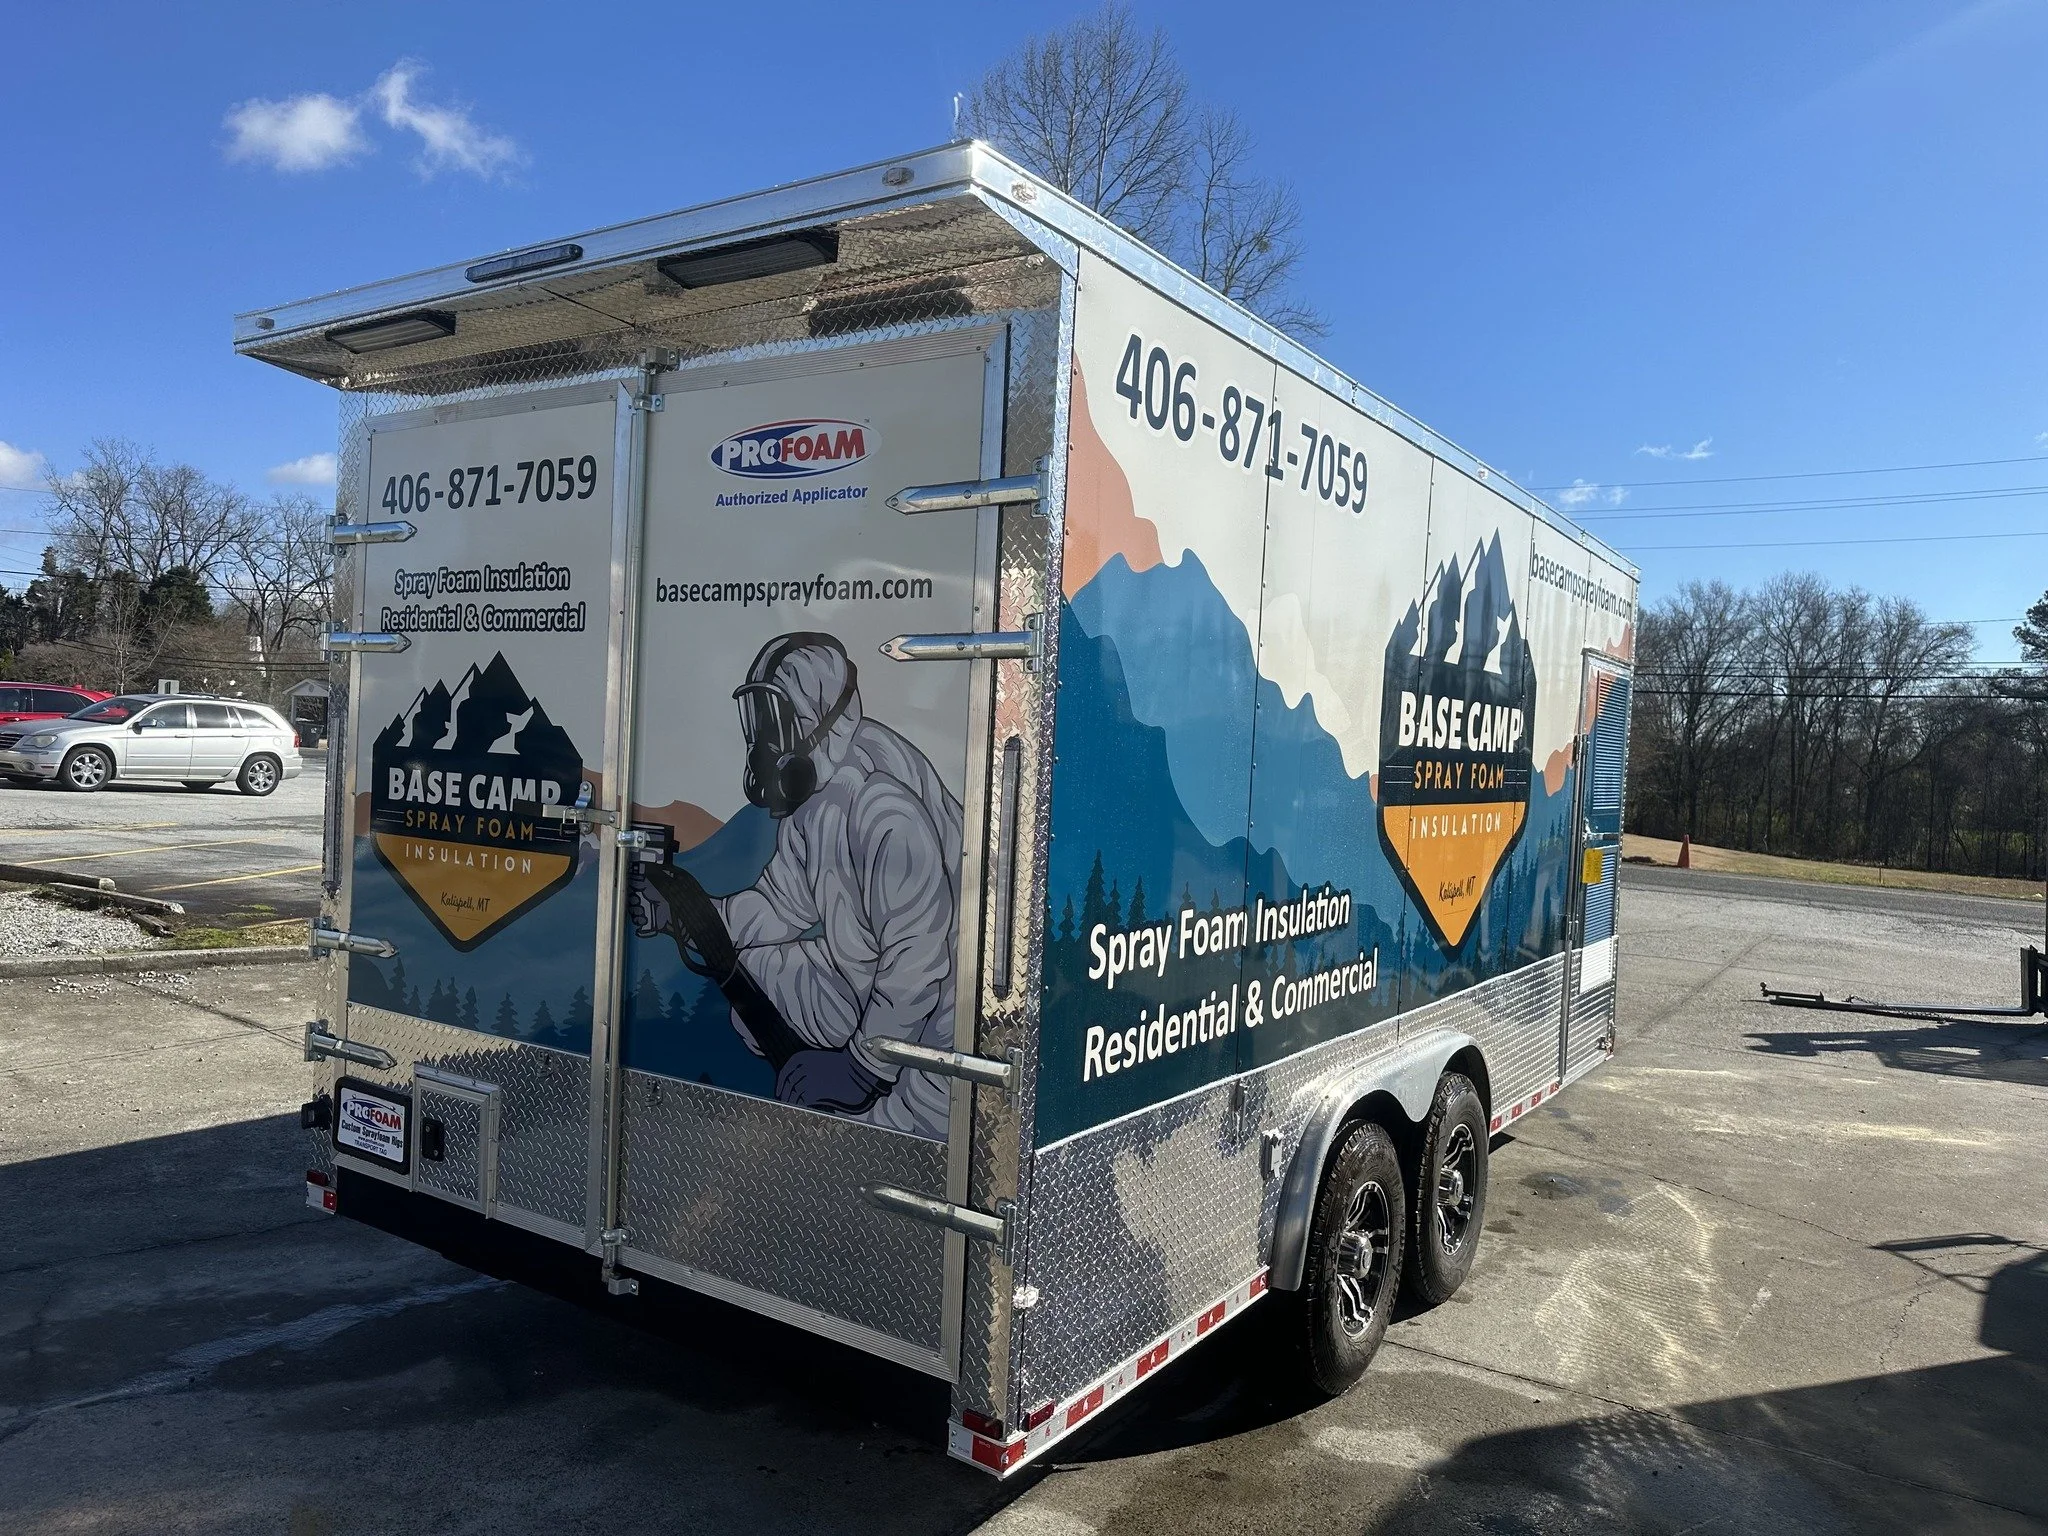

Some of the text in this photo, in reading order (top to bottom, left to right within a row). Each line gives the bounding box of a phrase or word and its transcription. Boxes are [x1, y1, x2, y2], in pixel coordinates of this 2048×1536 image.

[1116, 333, 1368, 514] 406-871-7059
[721, 428, 866, 470] PROFOAM
[382, 455, 597, 514] 406-871-7059
[715, 485, 868, 507] Authorized Applicator
[394, 561, 570, 599] Spray Foam Insulation
[656, 573, 933, 607] basecampsprayfoam.com
[380, 601, 586, 633] Residential & Commercial
[1398, 690, 1524, 753] BASE CAMP
[388, 767, 463, 807] BASE
[1414, 760, 1504, 789] SPRAY FOAM
[406, 809, 534, 841] SPRAY FOAM
[1412, 812, 1500, 839] INSULATION
[405, 843, 531, 874] INSULATION
[441, 891, 491, 912] Kalispell, MT
[1088, 886, 1351, 990] Spray Foam Insulation
[1083, 947, 1379, 1082] Residential & Commercial
[341, 1119, 361, 1134] Custom
[355, 1139, 379, 1153] TRANSPORT
